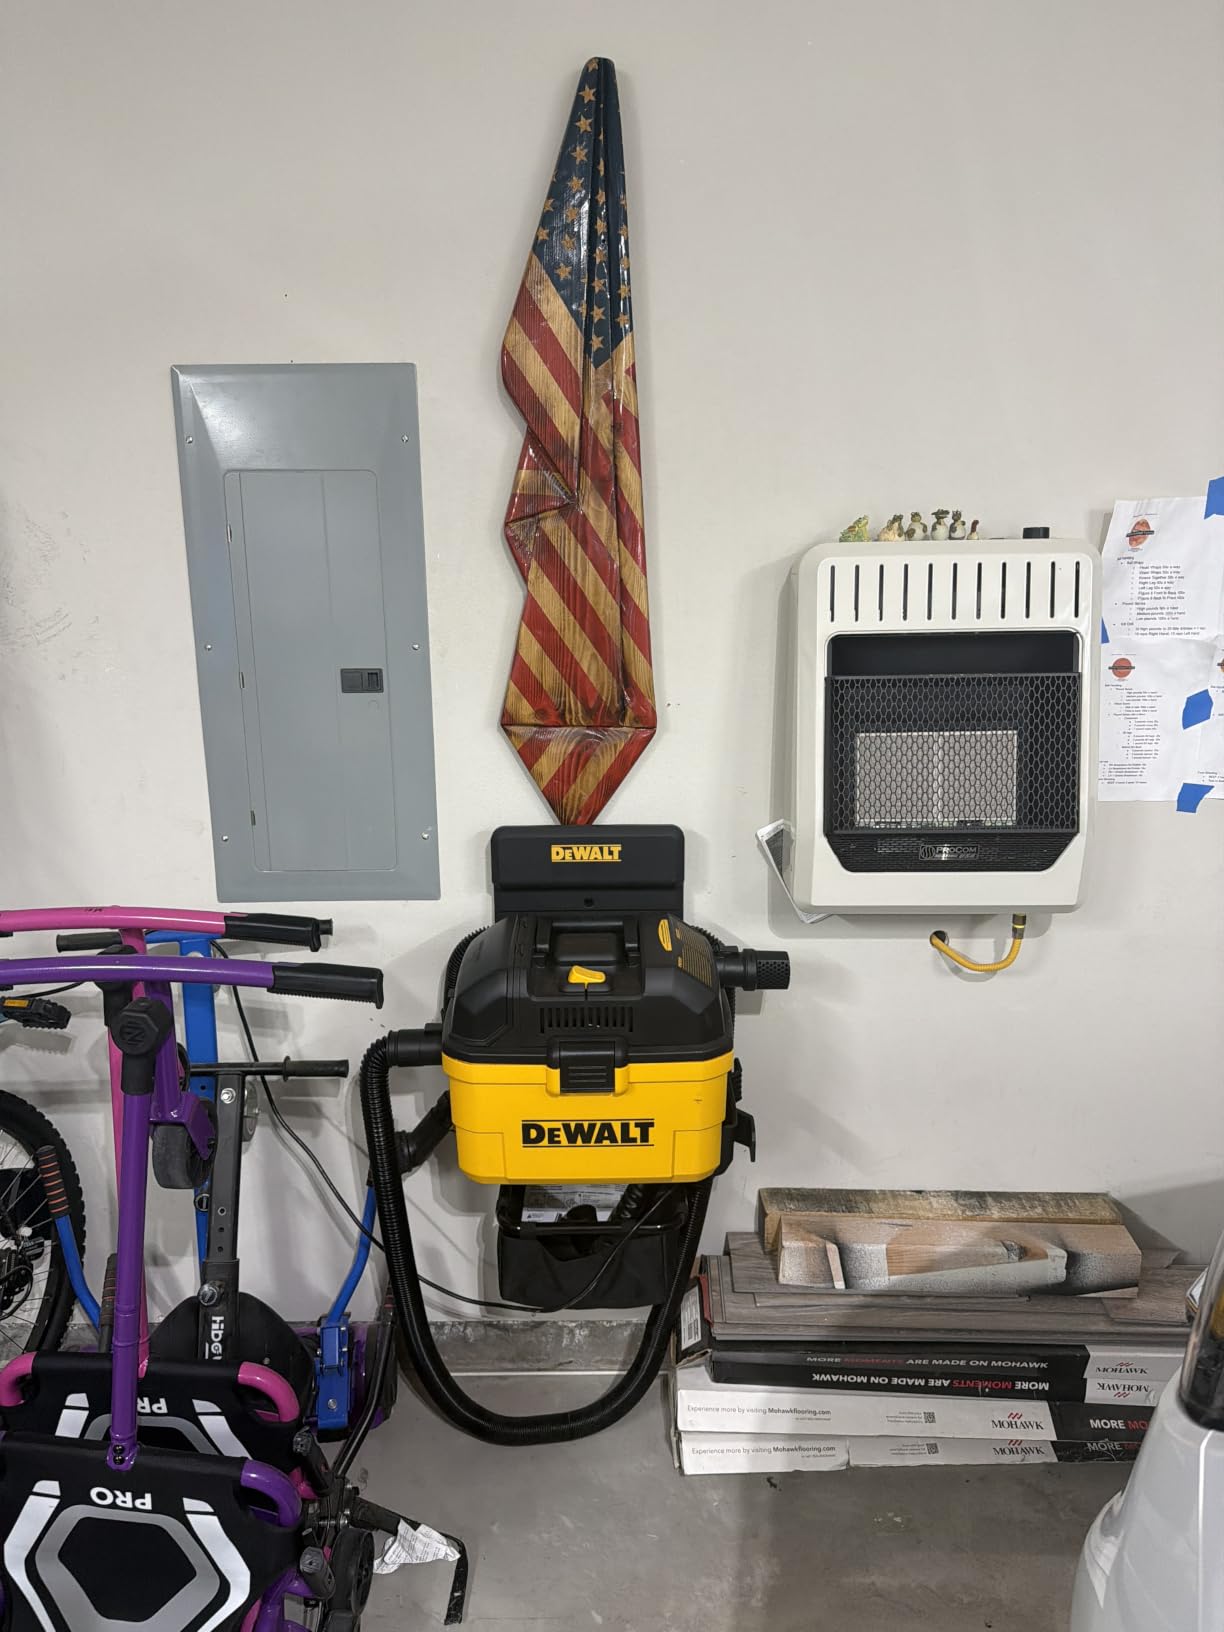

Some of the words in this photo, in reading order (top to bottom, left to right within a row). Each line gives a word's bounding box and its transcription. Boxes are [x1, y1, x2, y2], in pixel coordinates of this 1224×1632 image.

[211, 1316, 224, 1360] Hibo
[991, 1360, 1049, 1369] MOHAWK
[1095, 1366, 1148, 1375] MOHAWK
[812, 1373, 867, 1383] MOHAWK
[870, 1376, 889, 1385] ON
[891, 1377, 925, 1386] MADE
[928, 1378, 950, 1387] ARE
[952, 1379, 1012, 1389] MOMENTS
[1014, 1381, 1050, 1391] MORE
[1096, 1382, 1150, 1393] MOHAWK
[136, 1397, 168, 1414] PR
[687, 1405, 720, 1414] Experience
[737, 1406, 745, 1415] by
[746, 1406, 767, 1415] visiting
[767, 1407, 832, 1416] Mohawkflooring.com
[991, 1419, 1044, 1430] MOHAWK
[1089, 1418, 1126, 1429] MORE
[691, 1447, 725, 1455] Experience
[742, 1447, 750, 1455] by
[750, 1446, 772, 1455] visiting
[772, 1445, 836, 1453] Mohawkflooring.com
[992, 1446, 1045, 1456] MOHAWK
[1086, 1441, 1122, 1452] MORE
[89, 1486, 153, 1511] PRO
